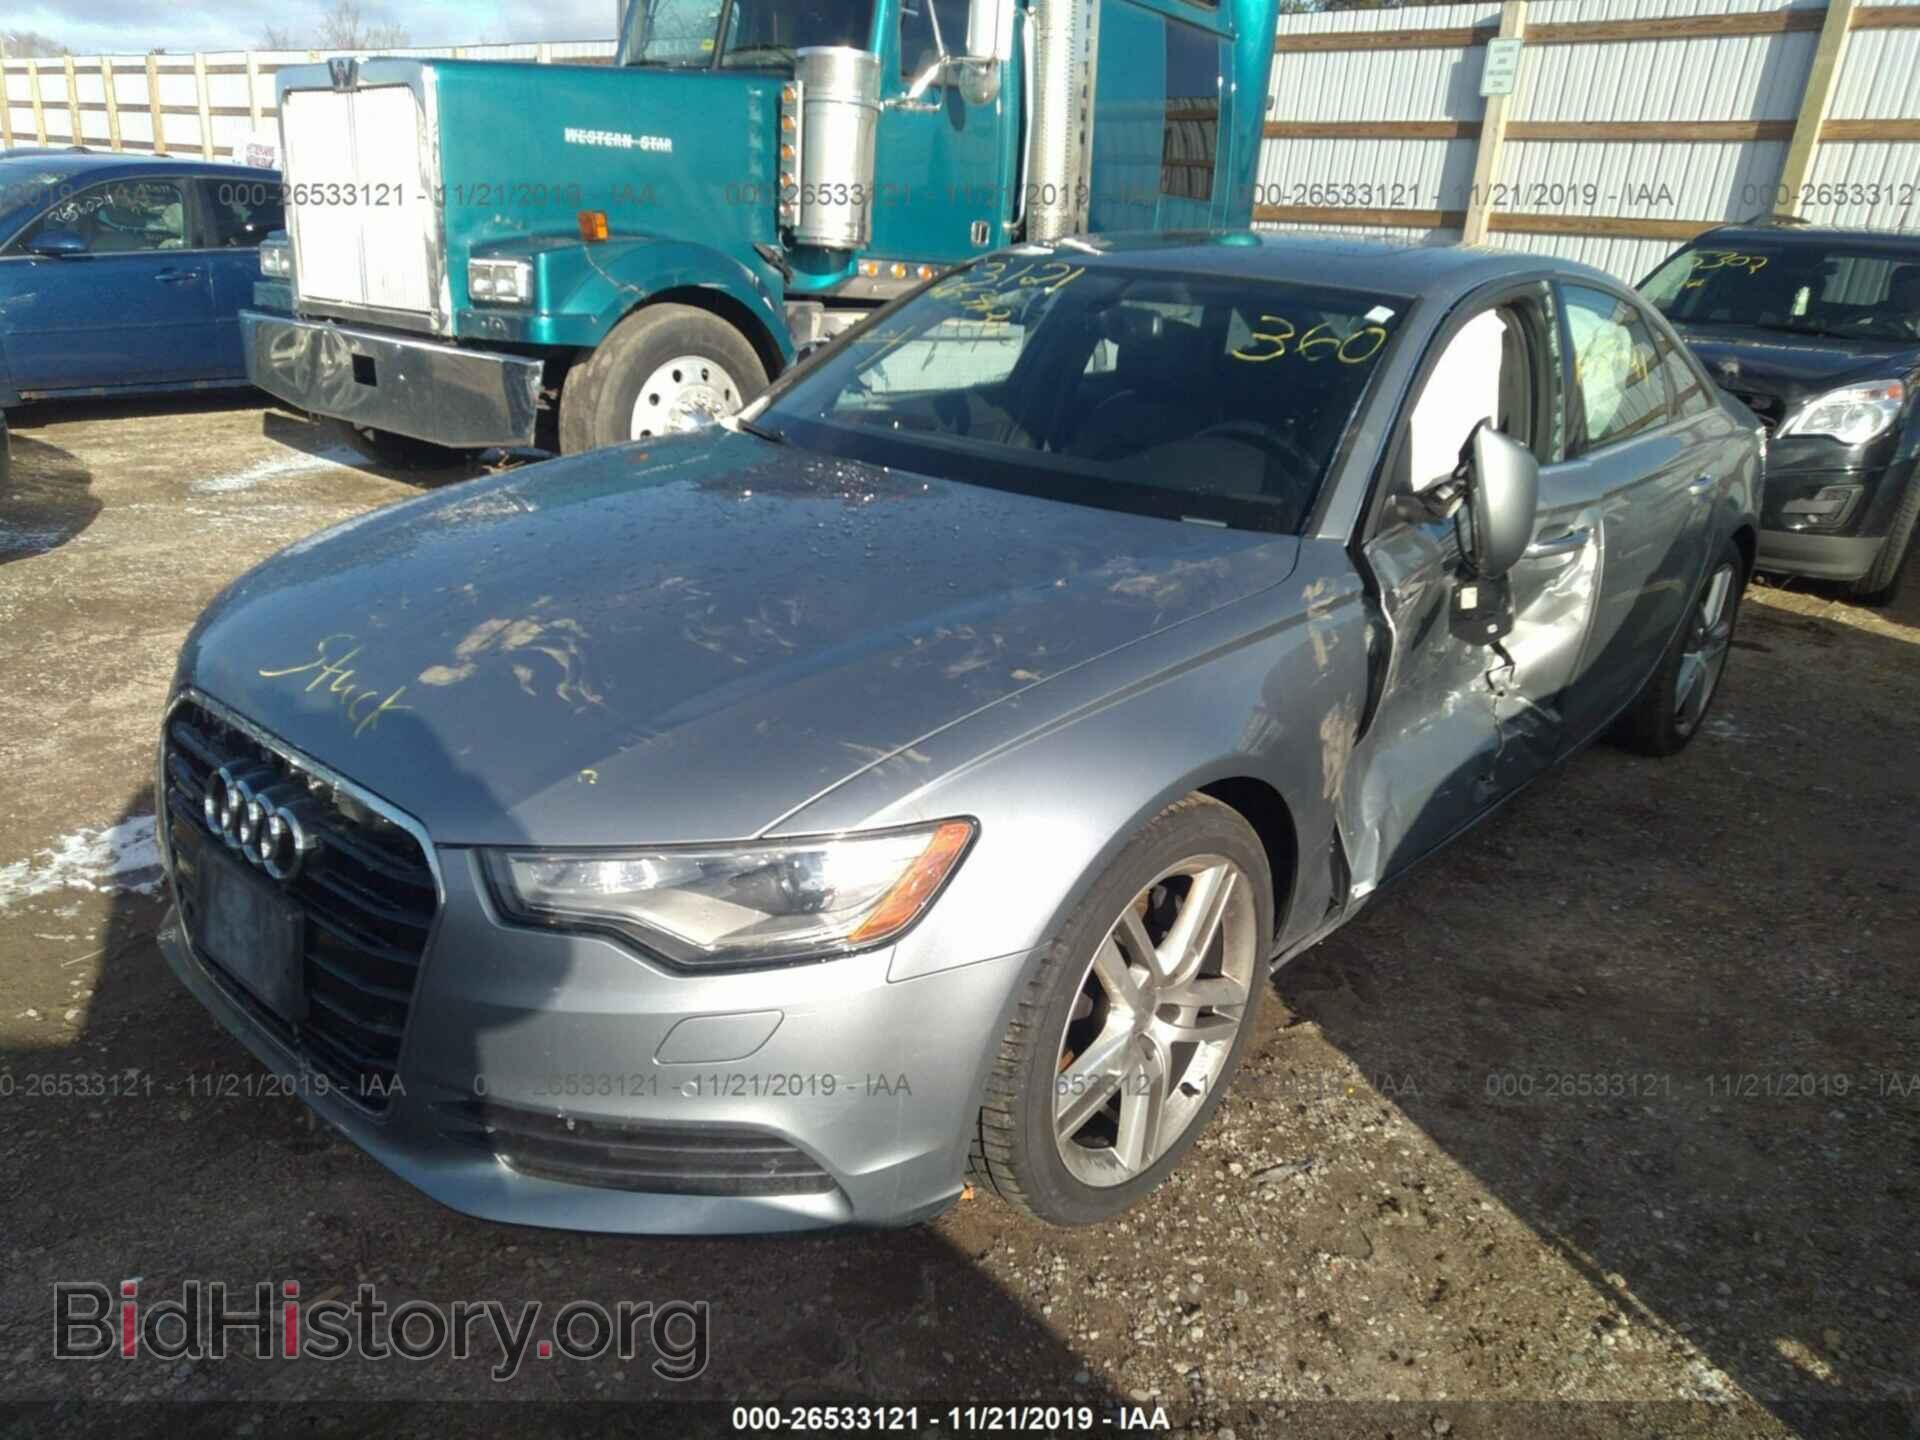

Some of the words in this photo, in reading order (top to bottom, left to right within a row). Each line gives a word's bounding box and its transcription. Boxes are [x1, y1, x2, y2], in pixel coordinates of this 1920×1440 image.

[564, 127, 632, 149] WESTERN
[640, 135, 672, 152] STAR
[1231, 314, 1387, 364] 360
